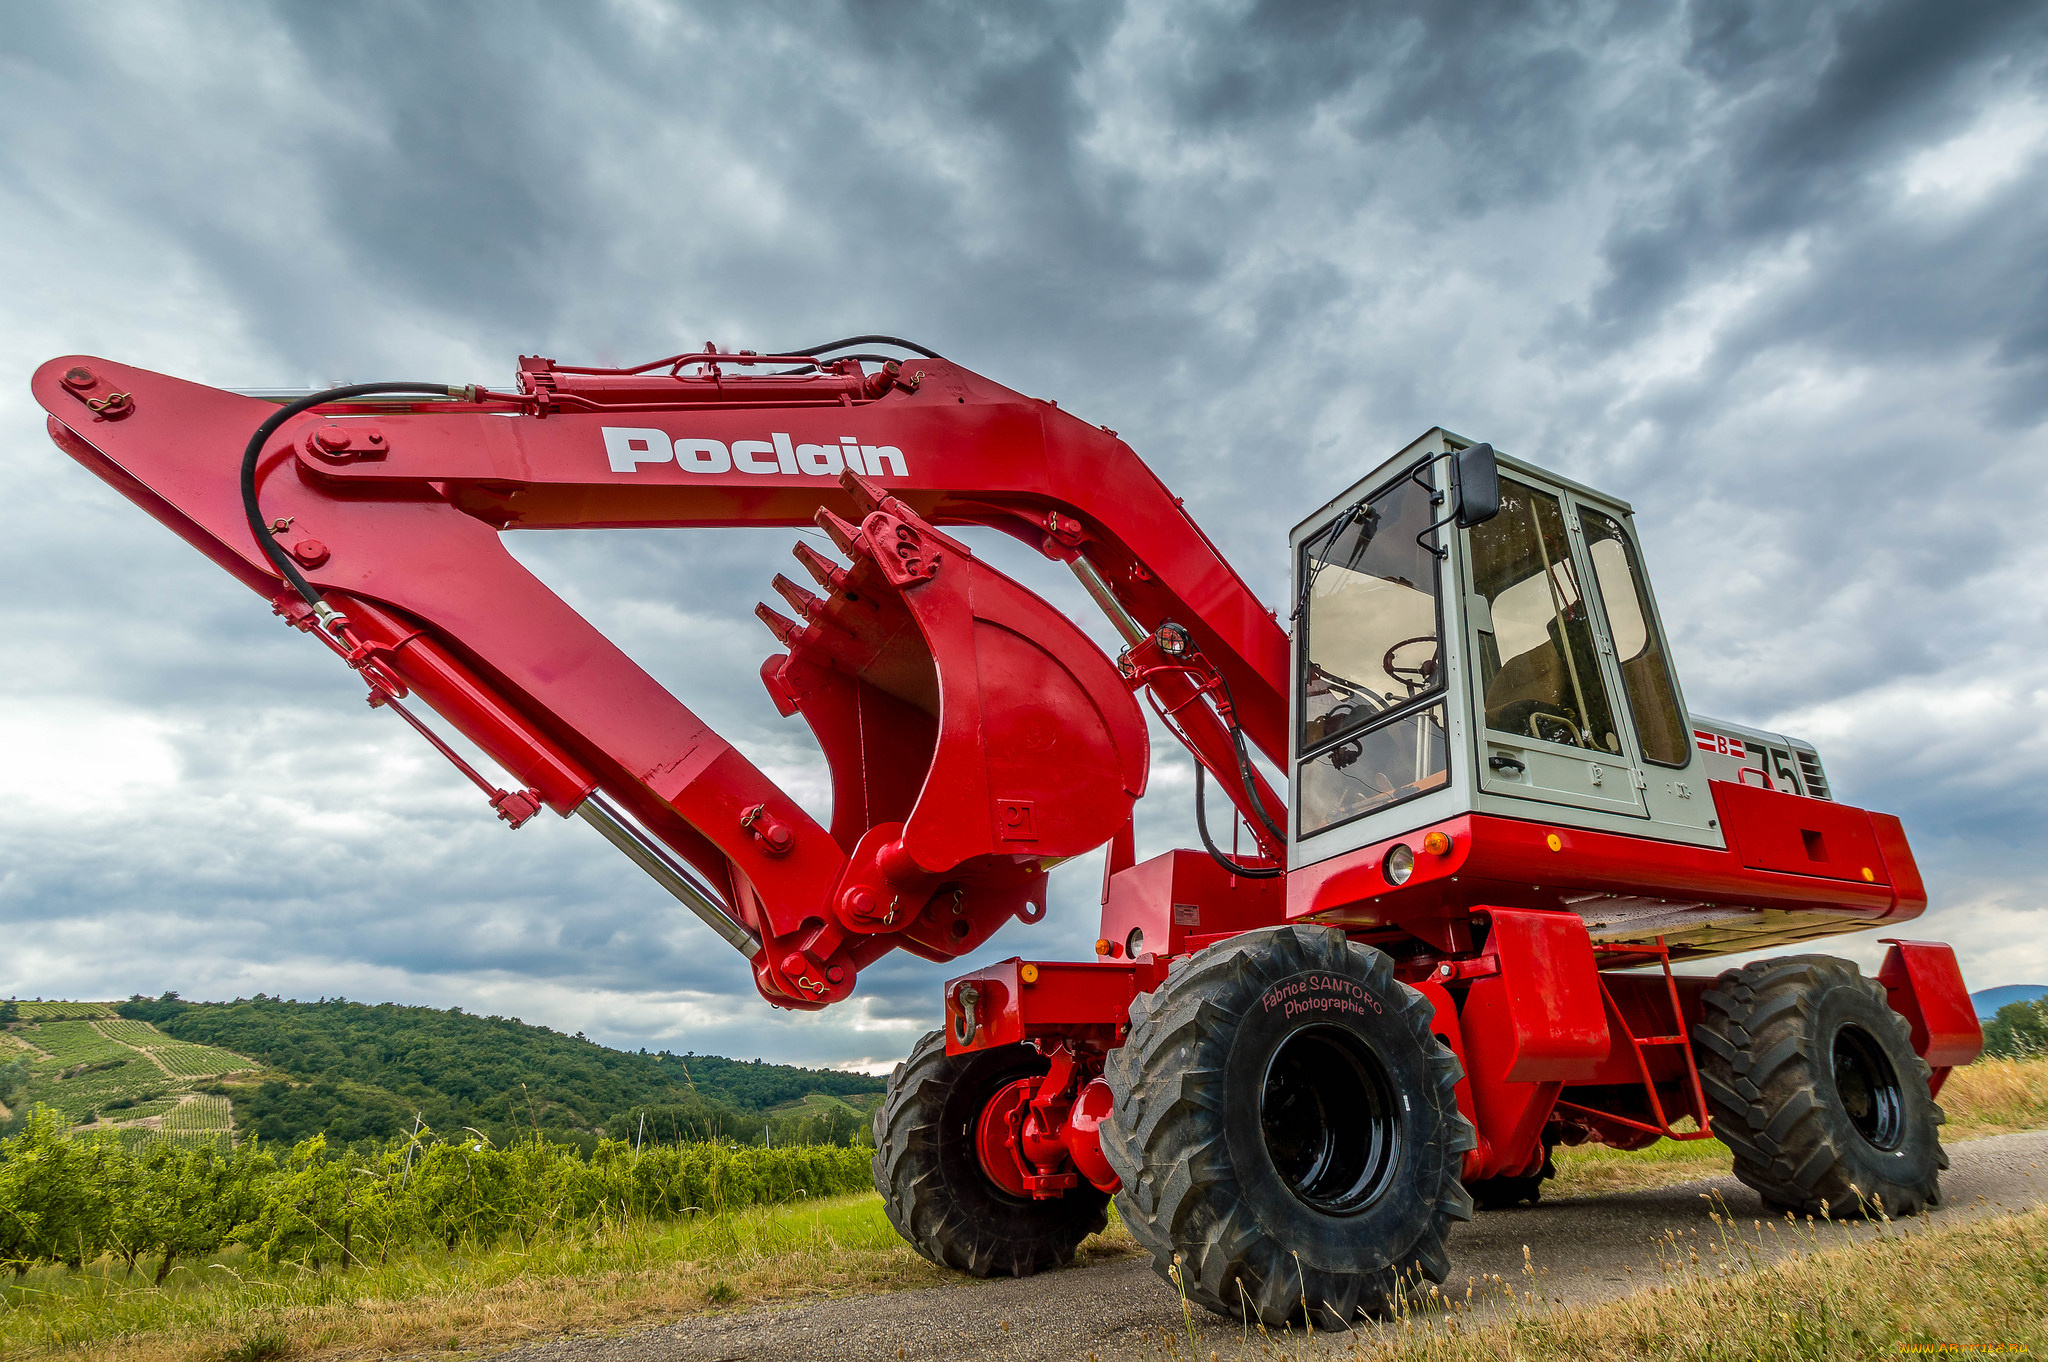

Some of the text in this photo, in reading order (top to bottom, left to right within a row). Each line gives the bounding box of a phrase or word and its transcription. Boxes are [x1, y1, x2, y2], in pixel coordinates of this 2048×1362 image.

[601, 426, 909, 477] Poclain
[1717, 735, 1802, 796] B 75
